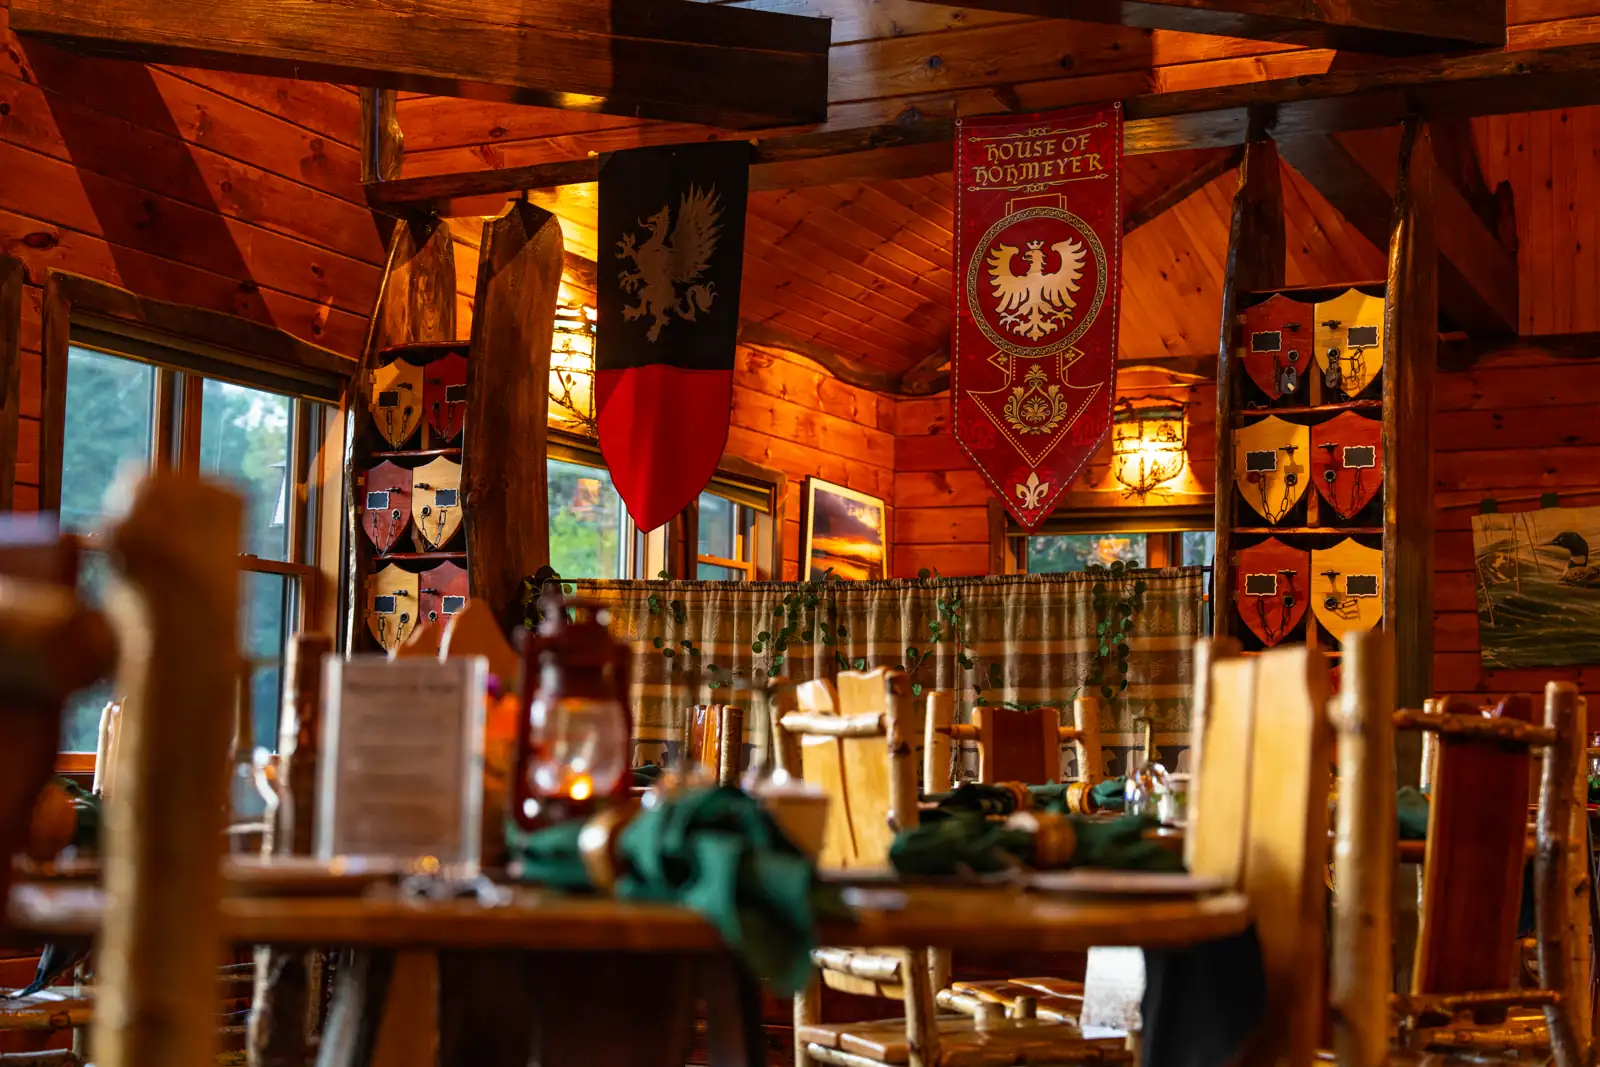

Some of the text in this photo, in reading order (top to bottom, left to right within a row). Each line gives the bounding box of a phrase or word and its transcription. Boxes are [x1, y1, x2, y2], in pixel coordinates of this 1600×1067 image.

[985, 134, 1092, 164] HOUSE OF
[973, 154, 1103, 186] HOHMEYER
